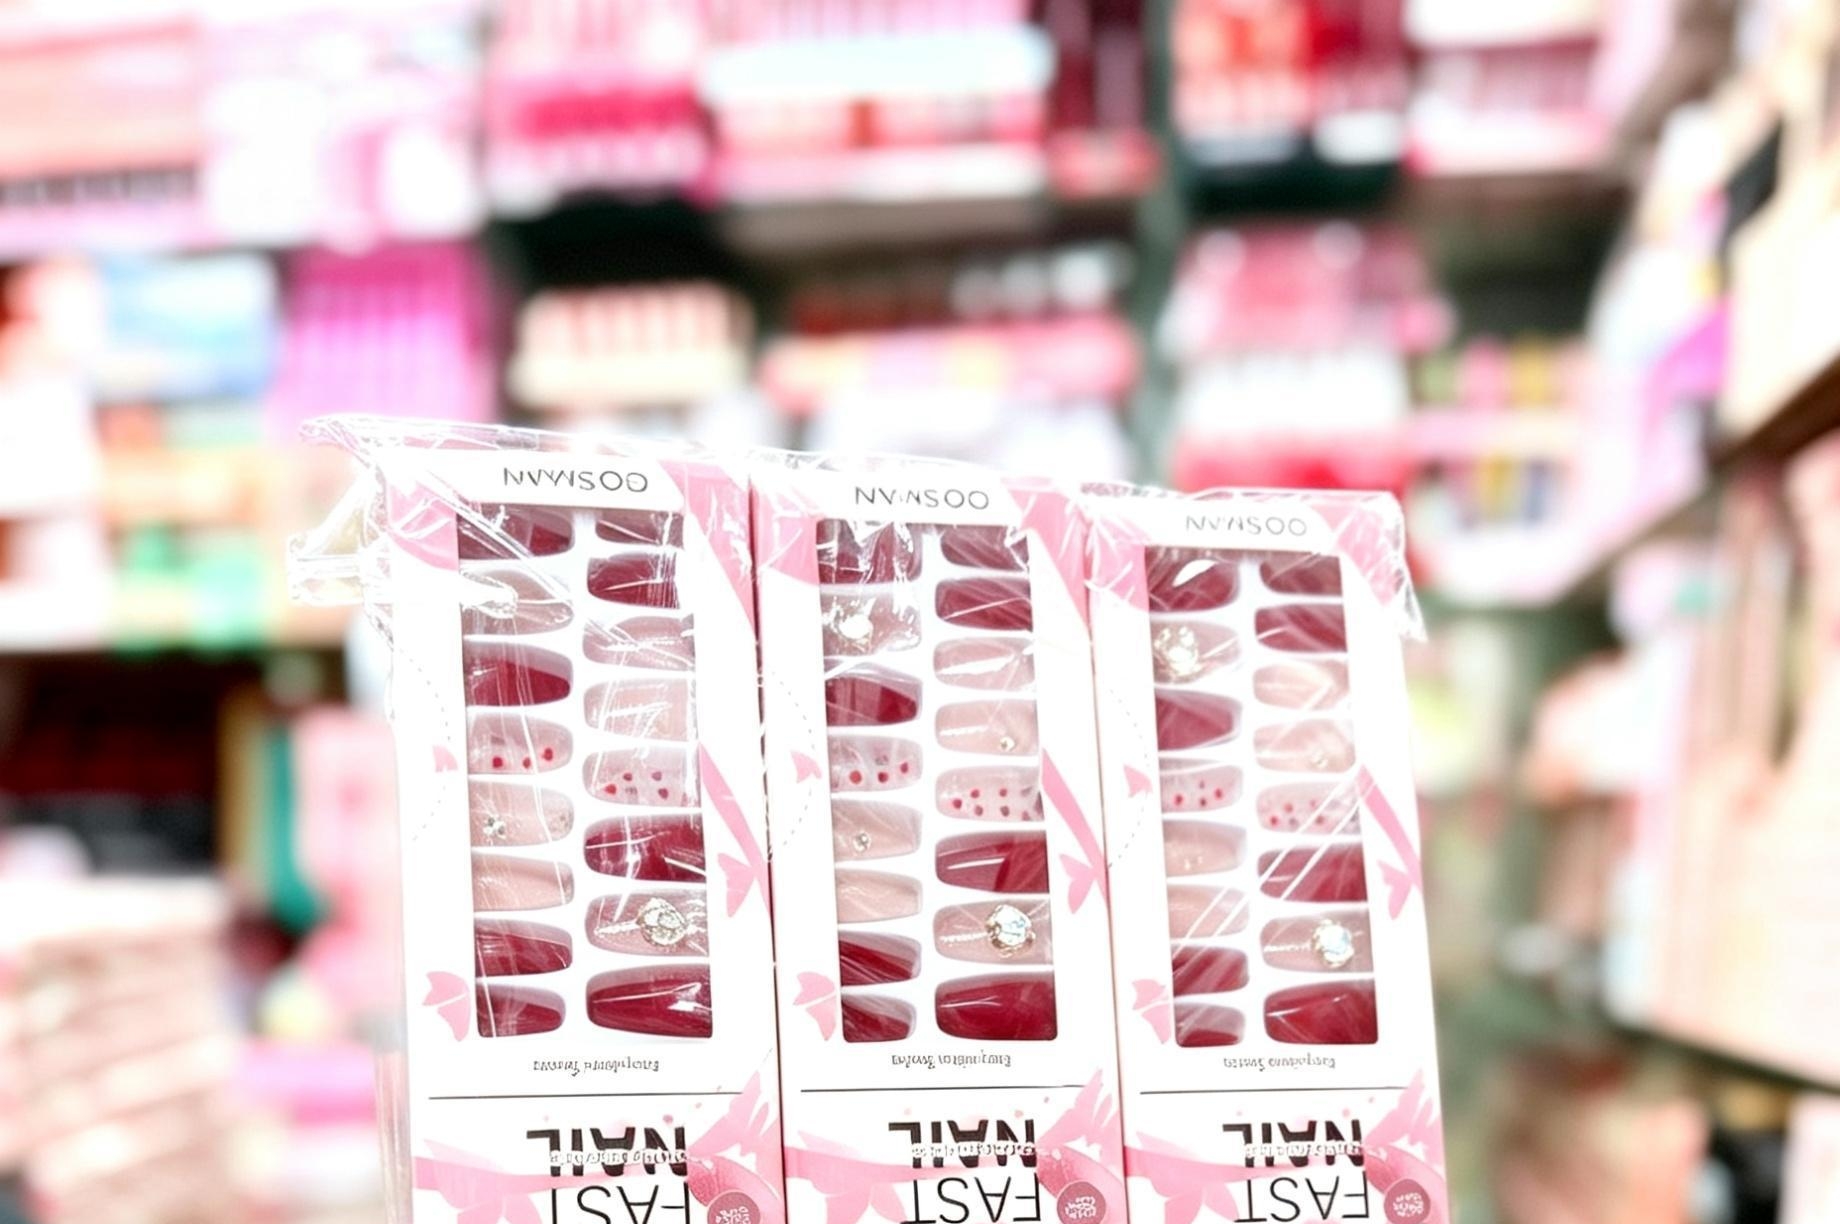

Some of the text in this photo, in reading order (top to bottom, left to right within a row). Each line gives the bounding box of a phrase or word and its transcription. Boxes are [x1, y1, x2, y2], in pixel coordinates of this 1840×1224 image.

[526, 1126, 689, 1178] NAIL
[888, 1119, 1038, 1169] NAIL
[1222, 1119, 1365, 1168] NAIL
[1233, 1170, 1370, 1223] FAST
